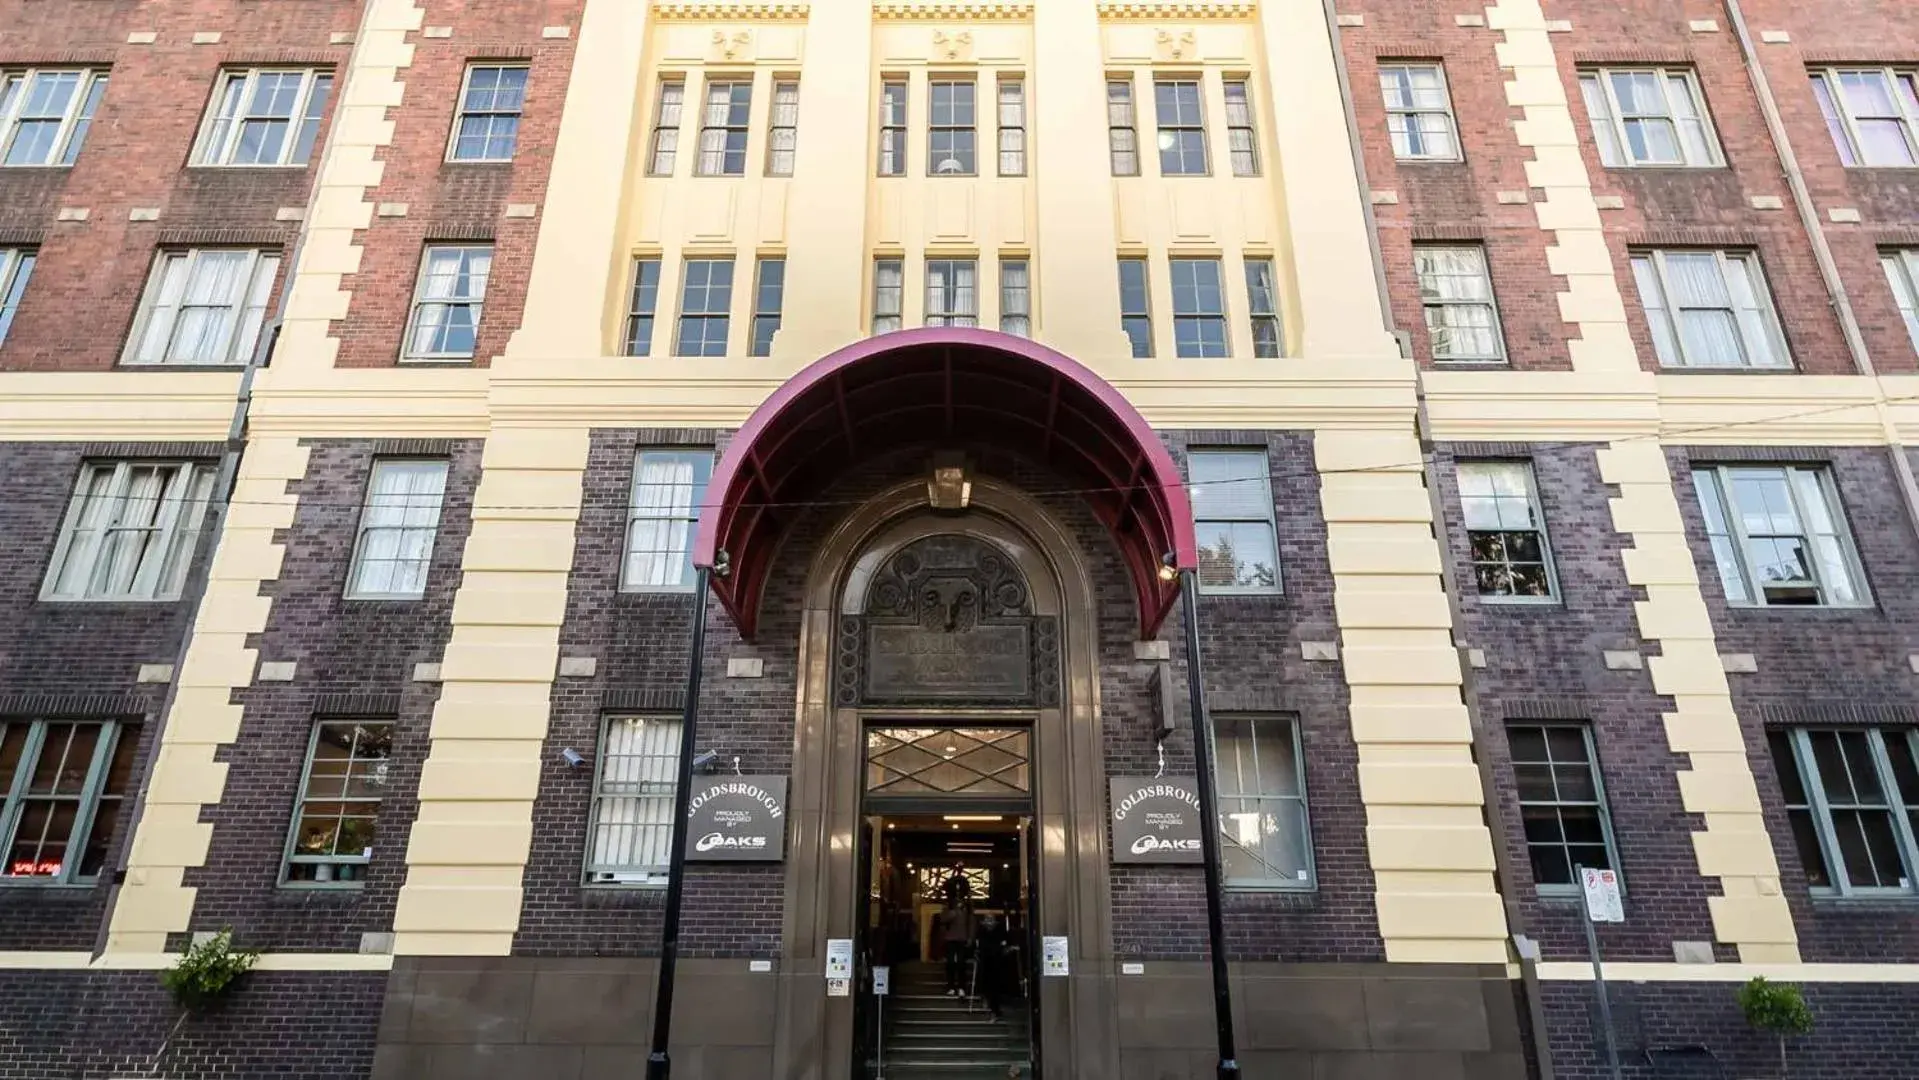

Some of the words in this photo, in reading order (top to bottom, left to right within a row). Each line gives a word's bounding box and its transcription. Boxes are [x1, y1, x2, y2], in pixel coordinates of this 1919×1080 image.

[688, 783, 782, 818] GOLDSBROUGH
[696, 832, 766, 851] OAKS
[1131, 835, 1201, 854] OAKS
